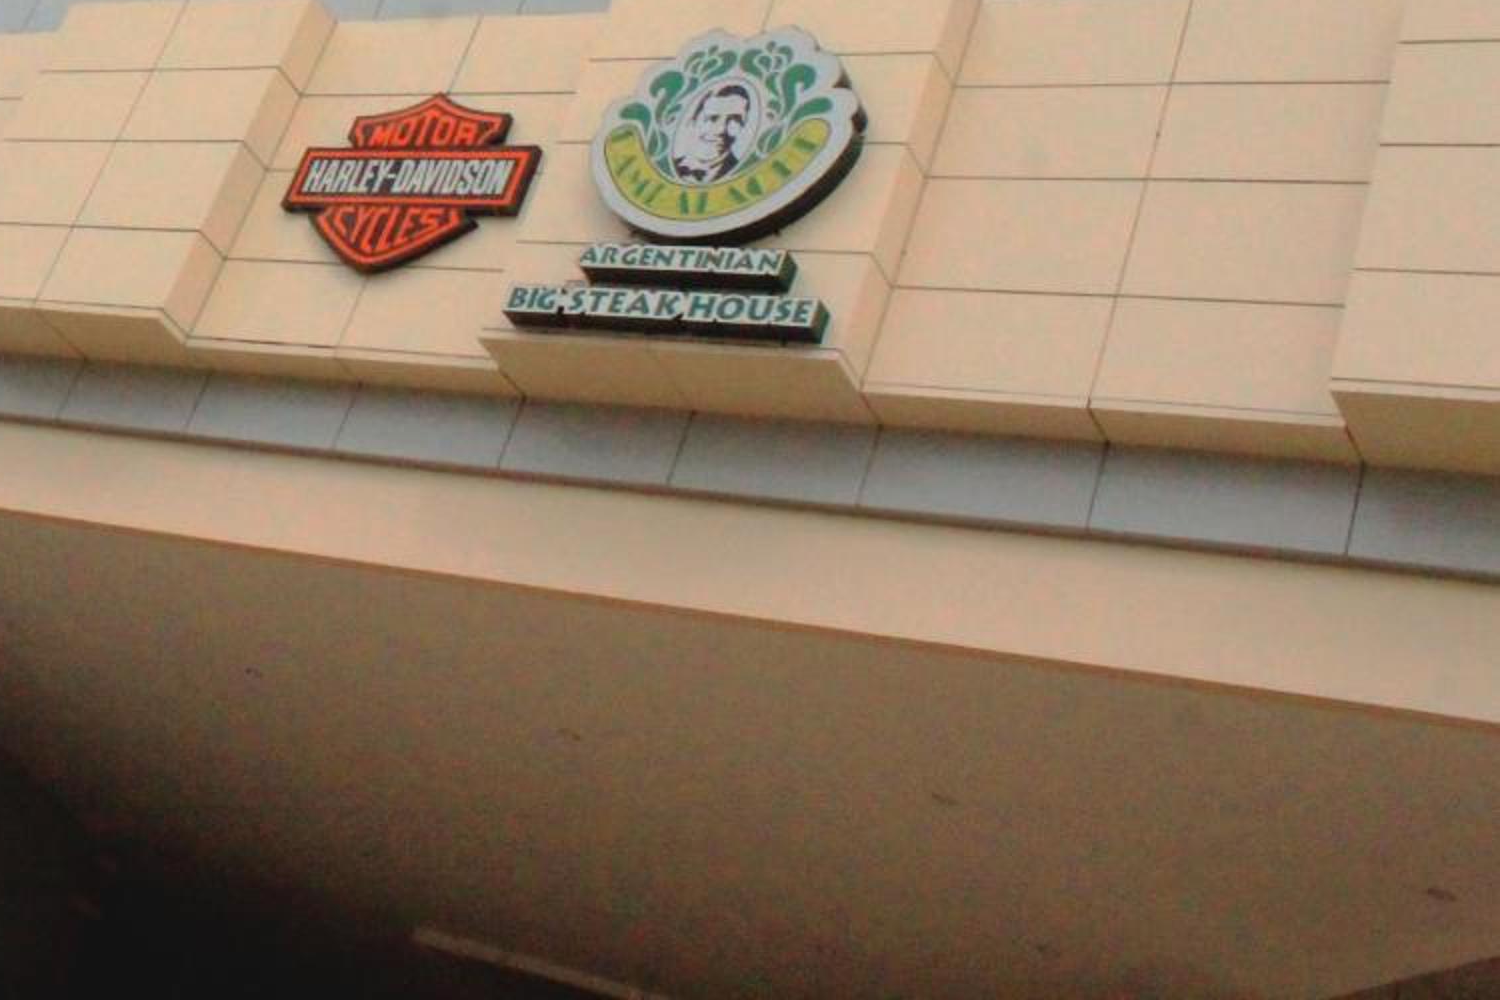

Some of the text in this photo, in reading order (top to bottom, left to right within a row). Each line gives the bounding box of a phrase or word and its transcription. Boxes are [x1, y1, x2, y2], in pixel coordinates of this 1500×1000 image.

[368, 109, 481, 147] MOTOR
[302, 159, 516, 196] HARLEY-DAVIDSON
[332, 205, 444, 252] CYCLES
[579, 246, 782, 274] ARGENTINIAN
[507, 286, 813, 325] BIG STEAK HOUSE
